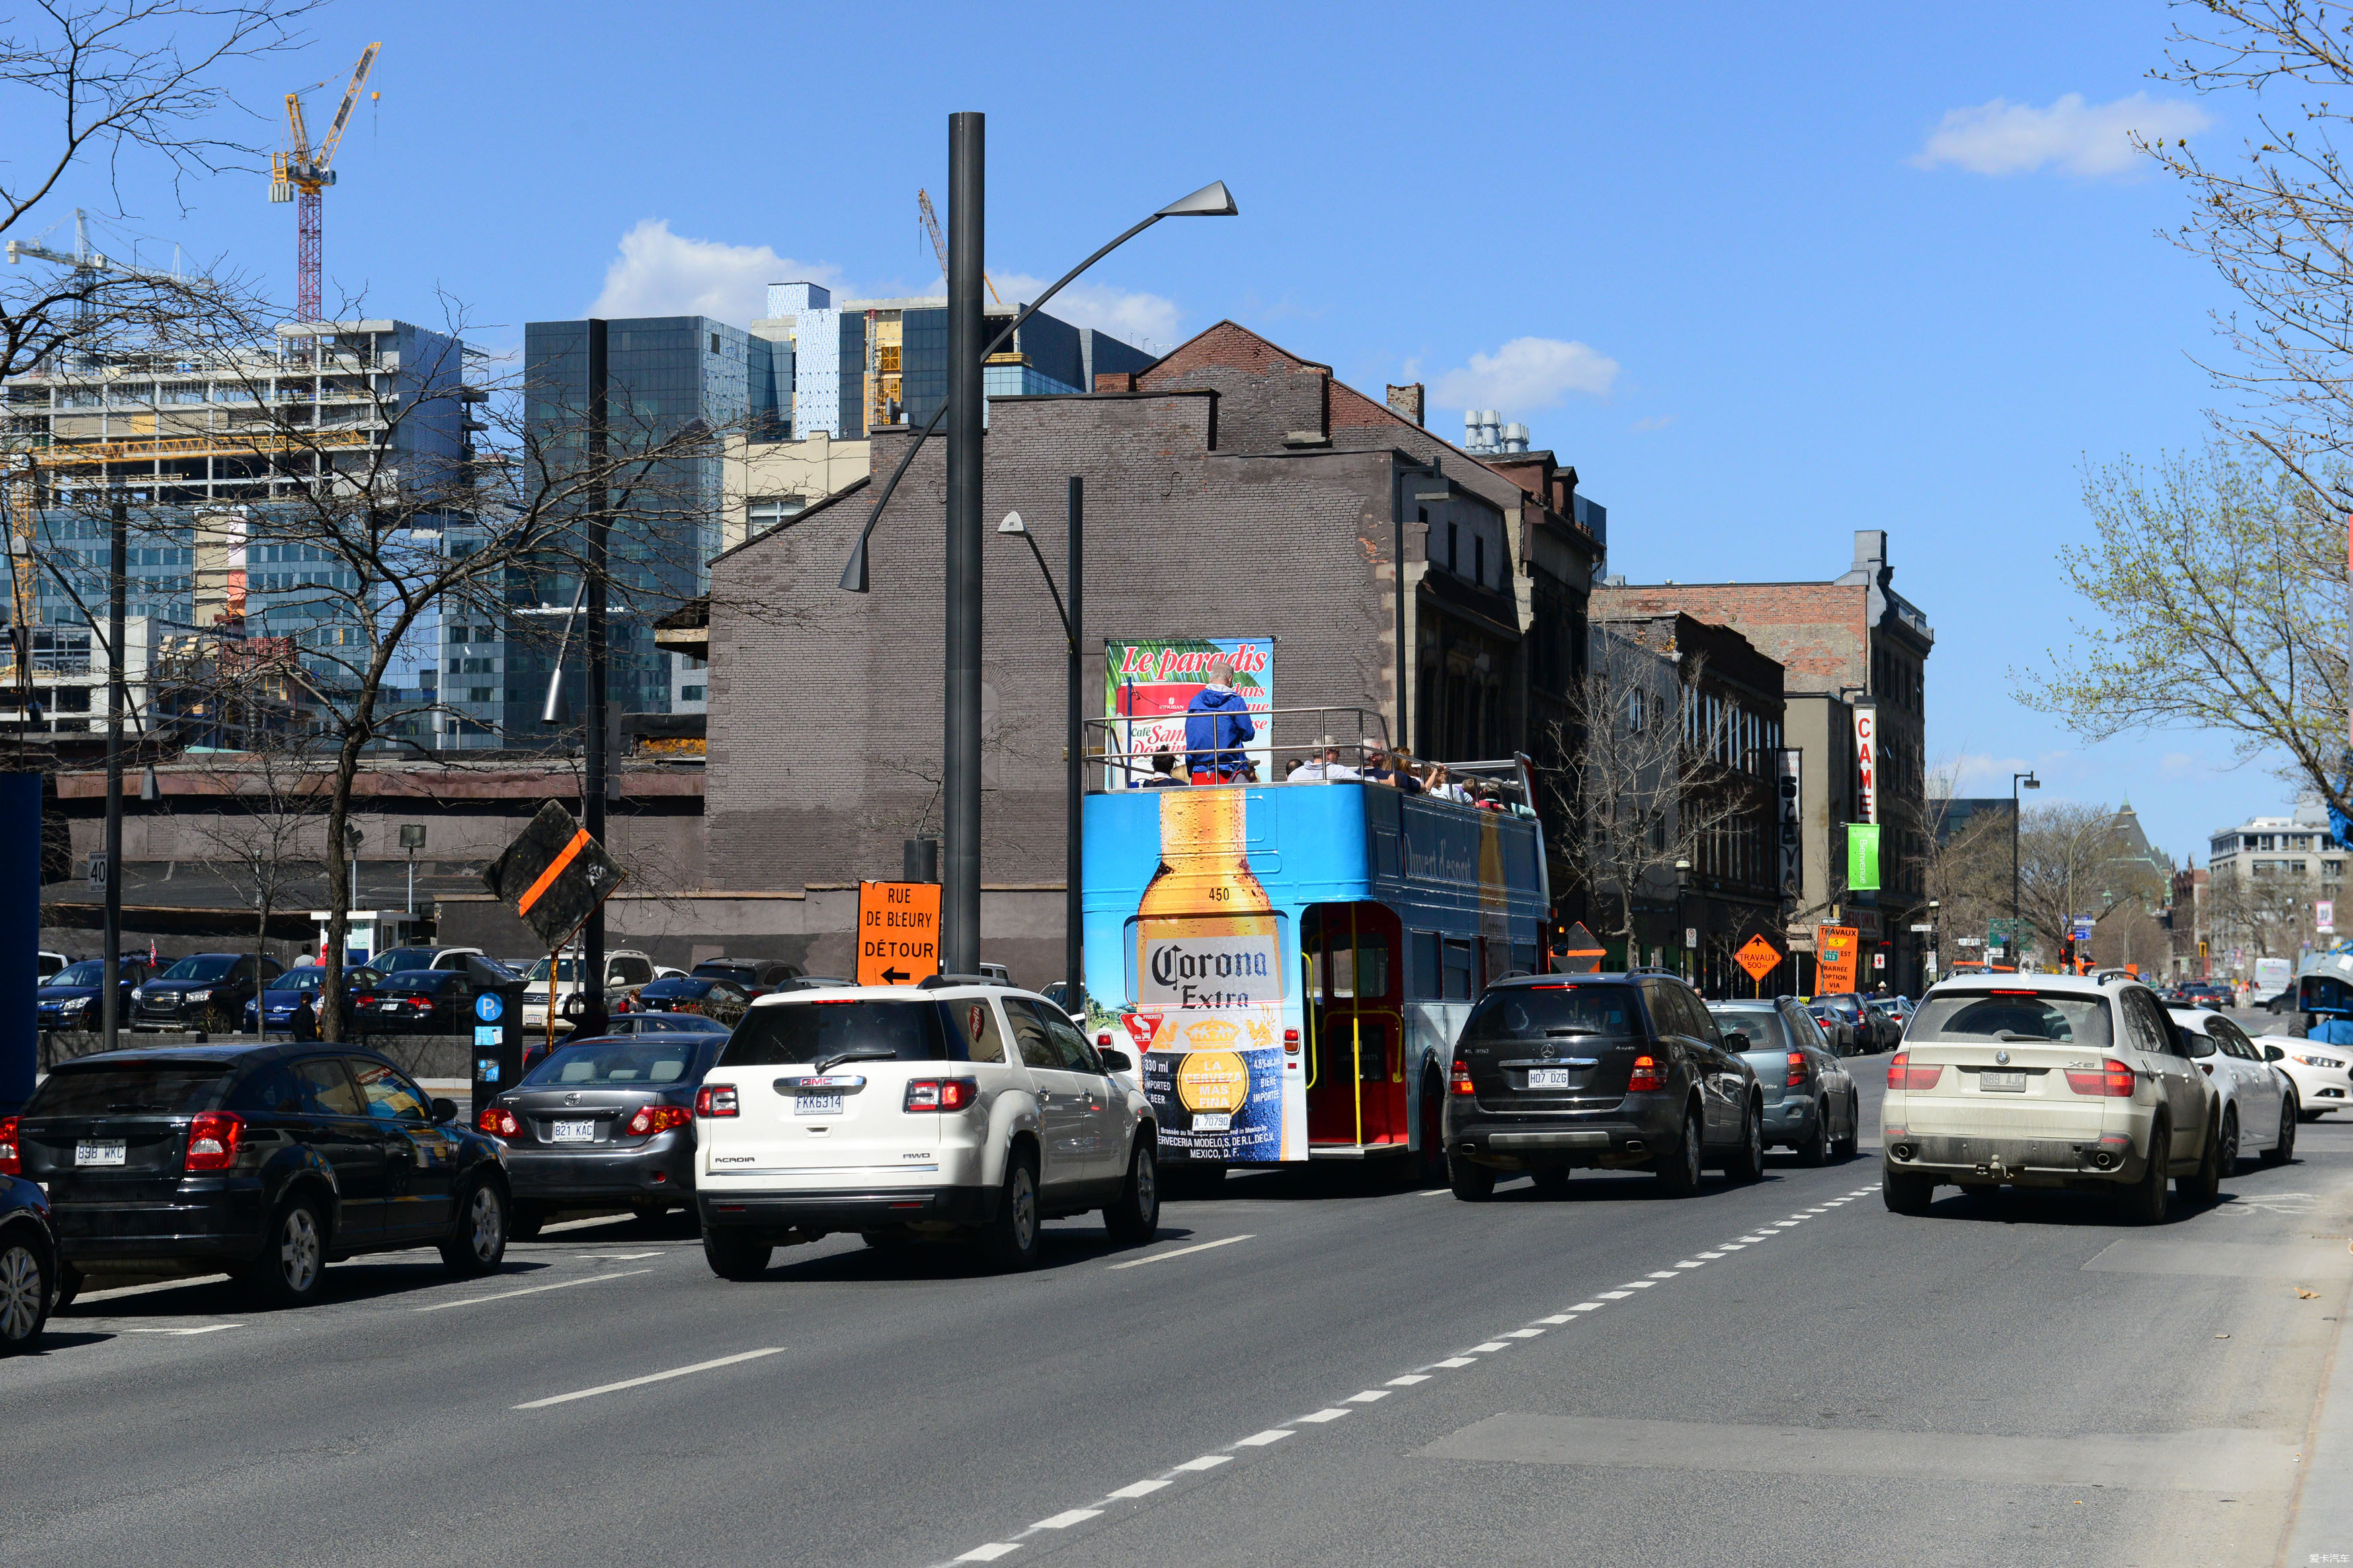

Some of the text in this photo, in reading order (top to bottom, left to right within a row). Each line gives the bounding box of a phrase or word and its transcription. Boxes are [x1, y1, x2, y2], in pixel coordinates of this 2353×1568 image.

[1120, 644, 1267, 681] Le paradis
[1131, 727, 1151, 737] Café
[1858, 718, 1872, 824] CAME
[1859, 839, 1867, 884] Bienvenue
[91, 861, 106, 882] 40
[888, 888, 911, 903] RUE
[1209, 888, 1230, 902] 450
[867, 911, 932, 927] DE BLEURY
[1821, 927, 1856, 937] TRAVAUX
[865, 939, 934, 958] DÉTOUR
[1739, 953, 1776, 961] TRAVAUX
[1152, 945, 1268, 991] Corona
[1181, 985, 1248, 1009] Extra
[1145, 1059, 1168, 1073] 330 ml
[1204, 1061, 1221, 1071] LA
[801, 1077, 833, 1085] GMC
[1185, 1071, 1242, 1083] CERVEZA
[1551, 1073, 1566, 1083] DZG
[1983, 1073, 2024, 1085] N89 AJC
[1145, 1079, 1170, 1091] IMPORTED
[1199, 1085, 1228, 1096] MAS
[1150, 1094, 1165, 1104] BEER
[1253, 1085, 1279, 1102] IMPORTÉE
[797, 1095, 841, 1109] FKK6314
[1199, 1097, 1230, 1108] FINA
[1194, 1116, 1229, 1127] A 70790
[555, 1125, 592, 1136] 821 KAC
[1160, 1127, 1179, 1135] Brassée
[1158, 1136, 1193, 1147] ERVECERIA
[78, 1145, 124, 1159] 898 WKC
[1190, 1148, 1239, 1159] MEXICO, D. F.
